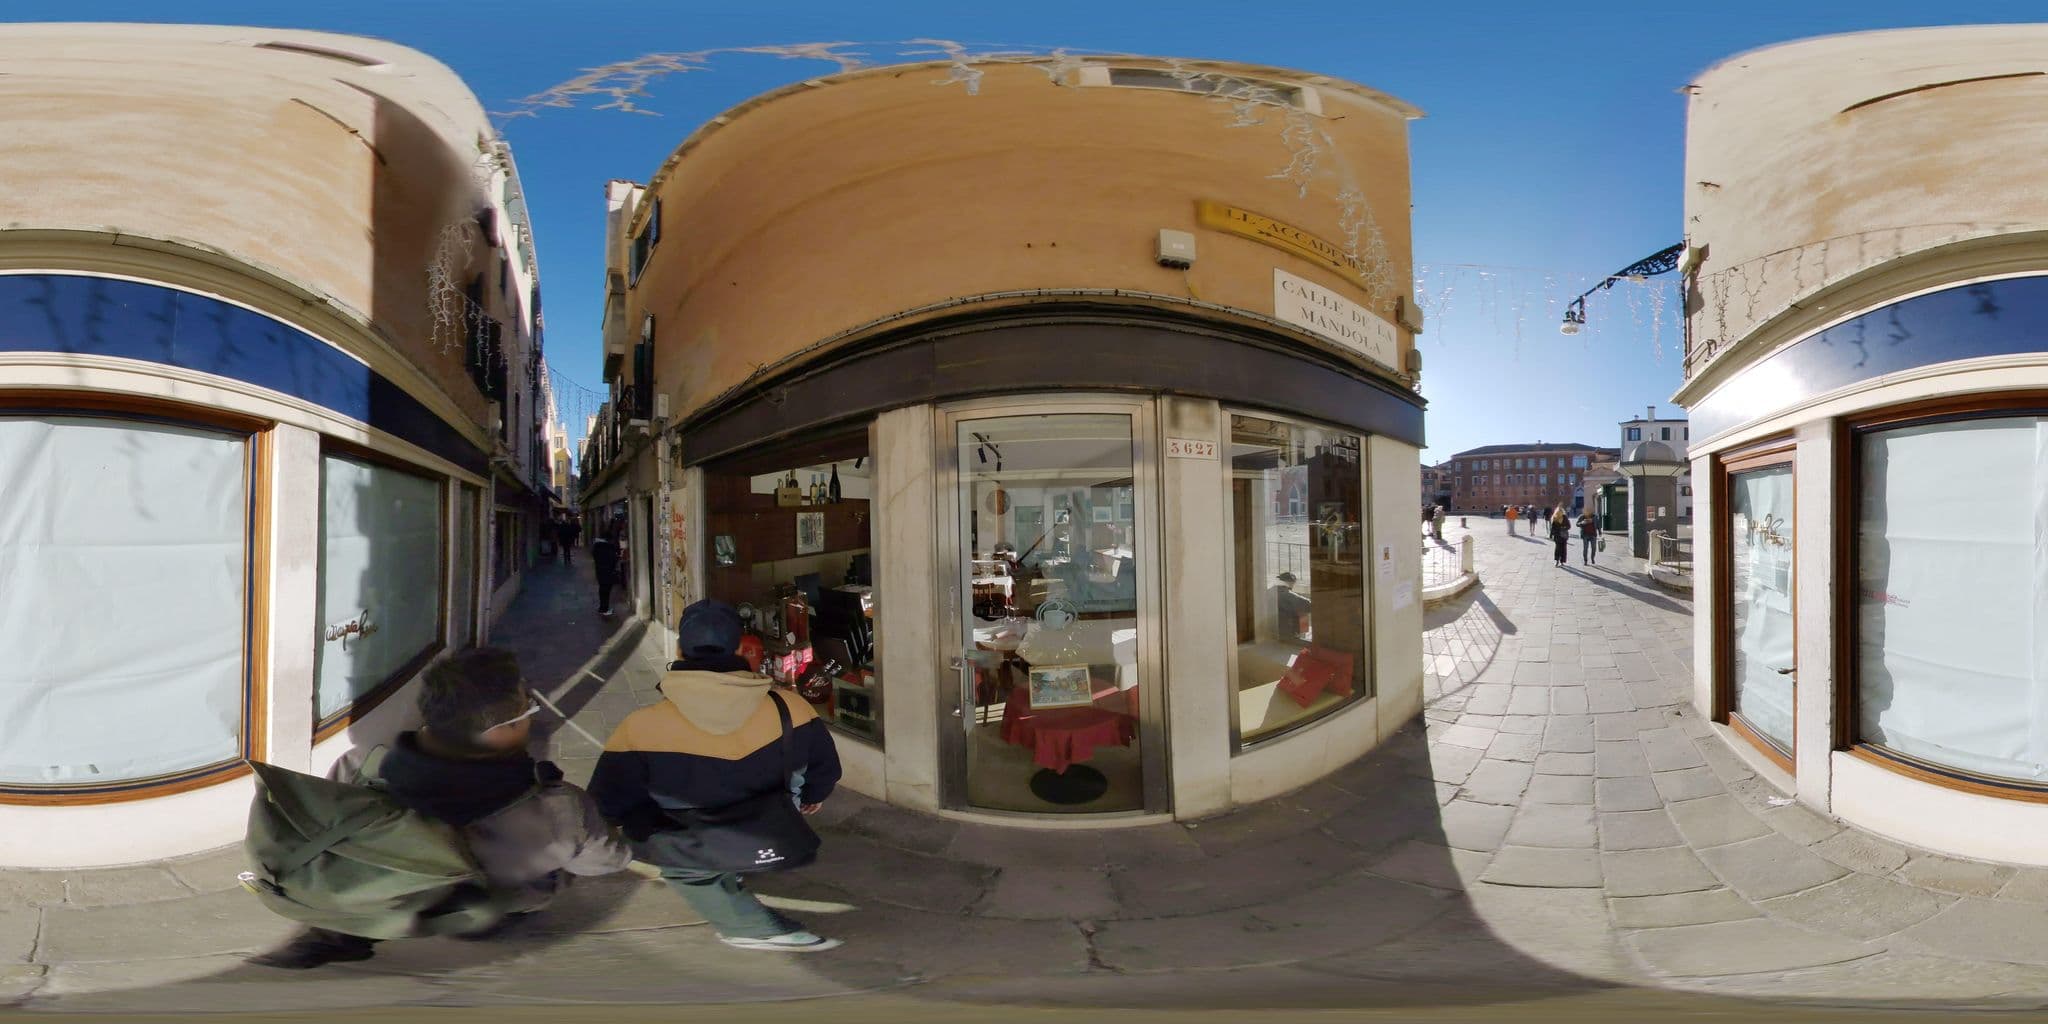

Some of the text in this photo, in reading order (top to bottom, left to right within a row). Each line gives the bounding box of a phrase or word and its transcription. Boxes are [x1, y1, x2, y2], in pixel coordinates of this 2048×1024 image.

[1281, 280, 1393, 342] CALLE DE LA
[1300, 306, 1381, 353] MANDOLA
